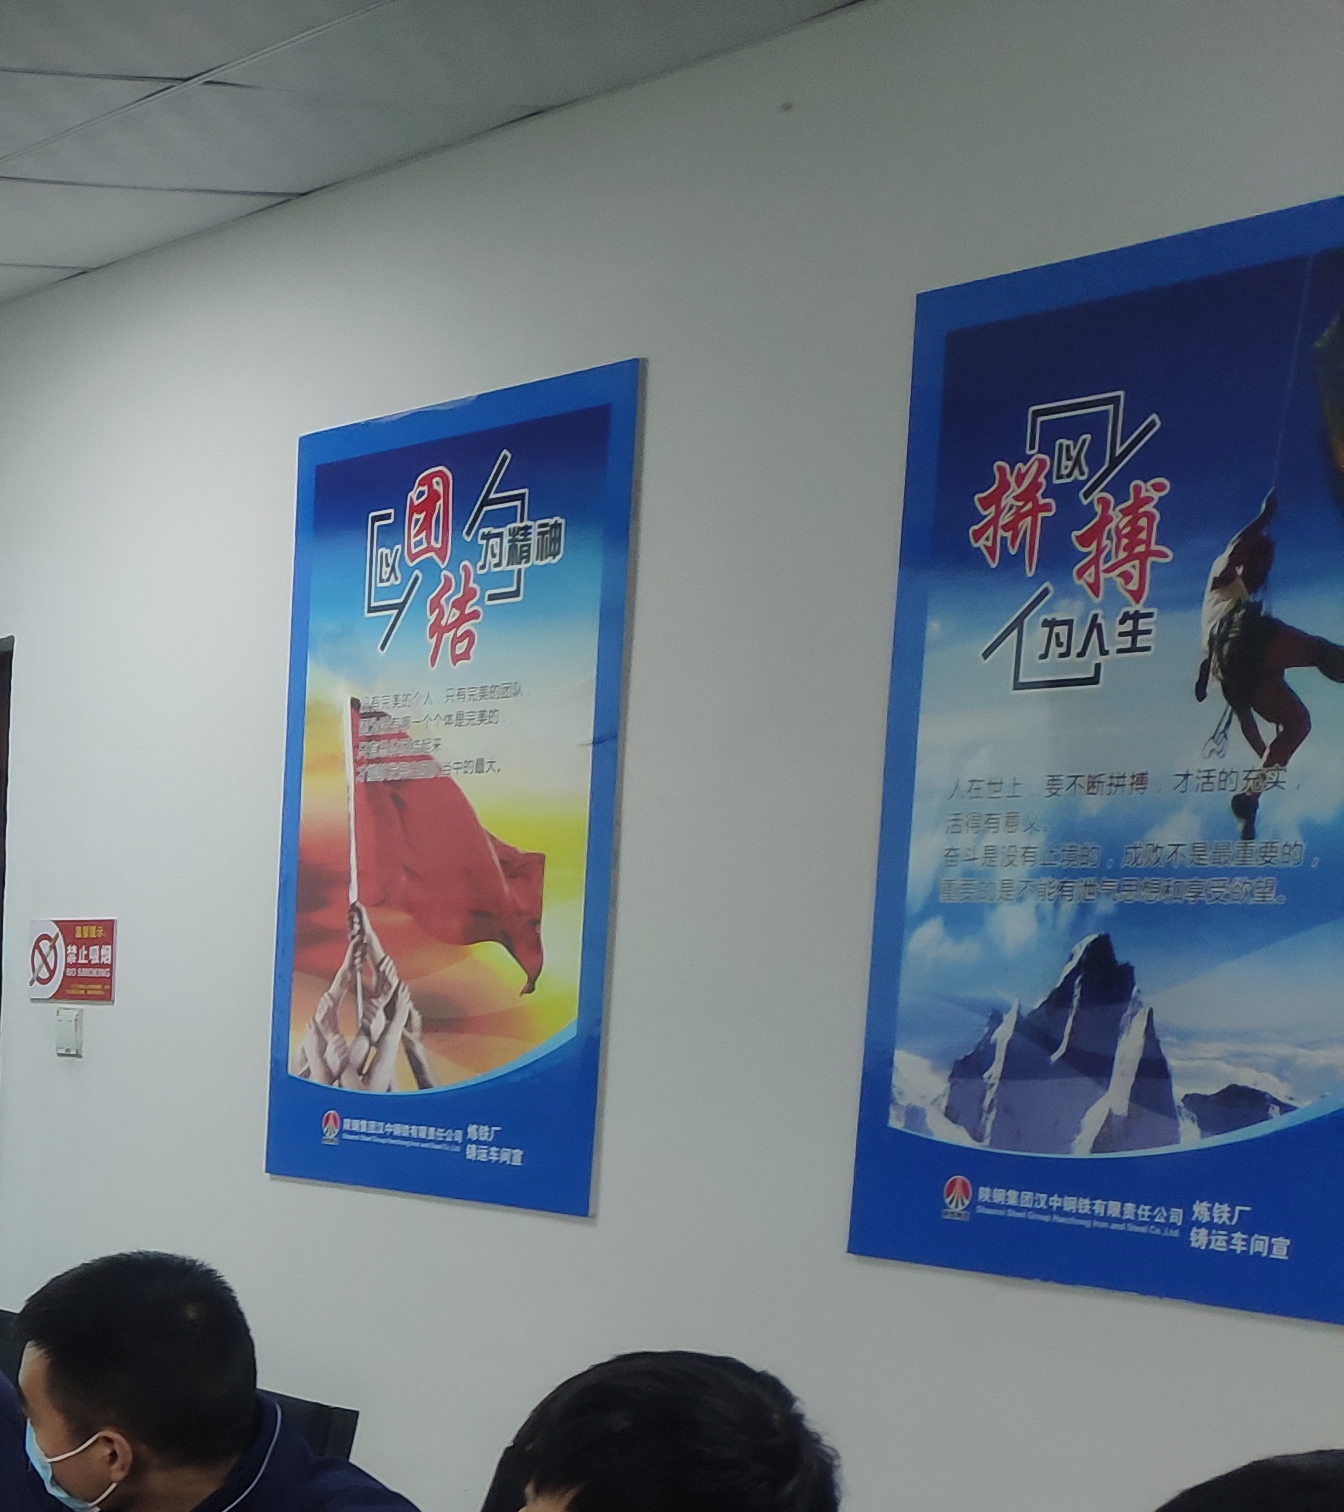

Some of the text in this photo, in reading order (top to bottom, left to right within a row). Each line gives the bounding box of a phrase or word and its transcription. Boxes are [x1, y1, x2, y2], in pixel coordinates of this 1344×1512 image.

[1053, 432, 1092, 484] 以
[477, 518, 566, 574] 为精神
[969, 452, 1175, 606] 拼搏
[378, 545, 401, 587] 以
[1037, 607, 1157, 661] 为人生
[944, 810, 1050, 835] 活得有意义。
[66, 944, 112, 965] 禁止吸烟
[978, 1186, 1252, 1226] 陕钢集团汉中钢铁有限责任公司 炼铁厂
[1189, 1227, 1292, 1260] 铸运车间宣
